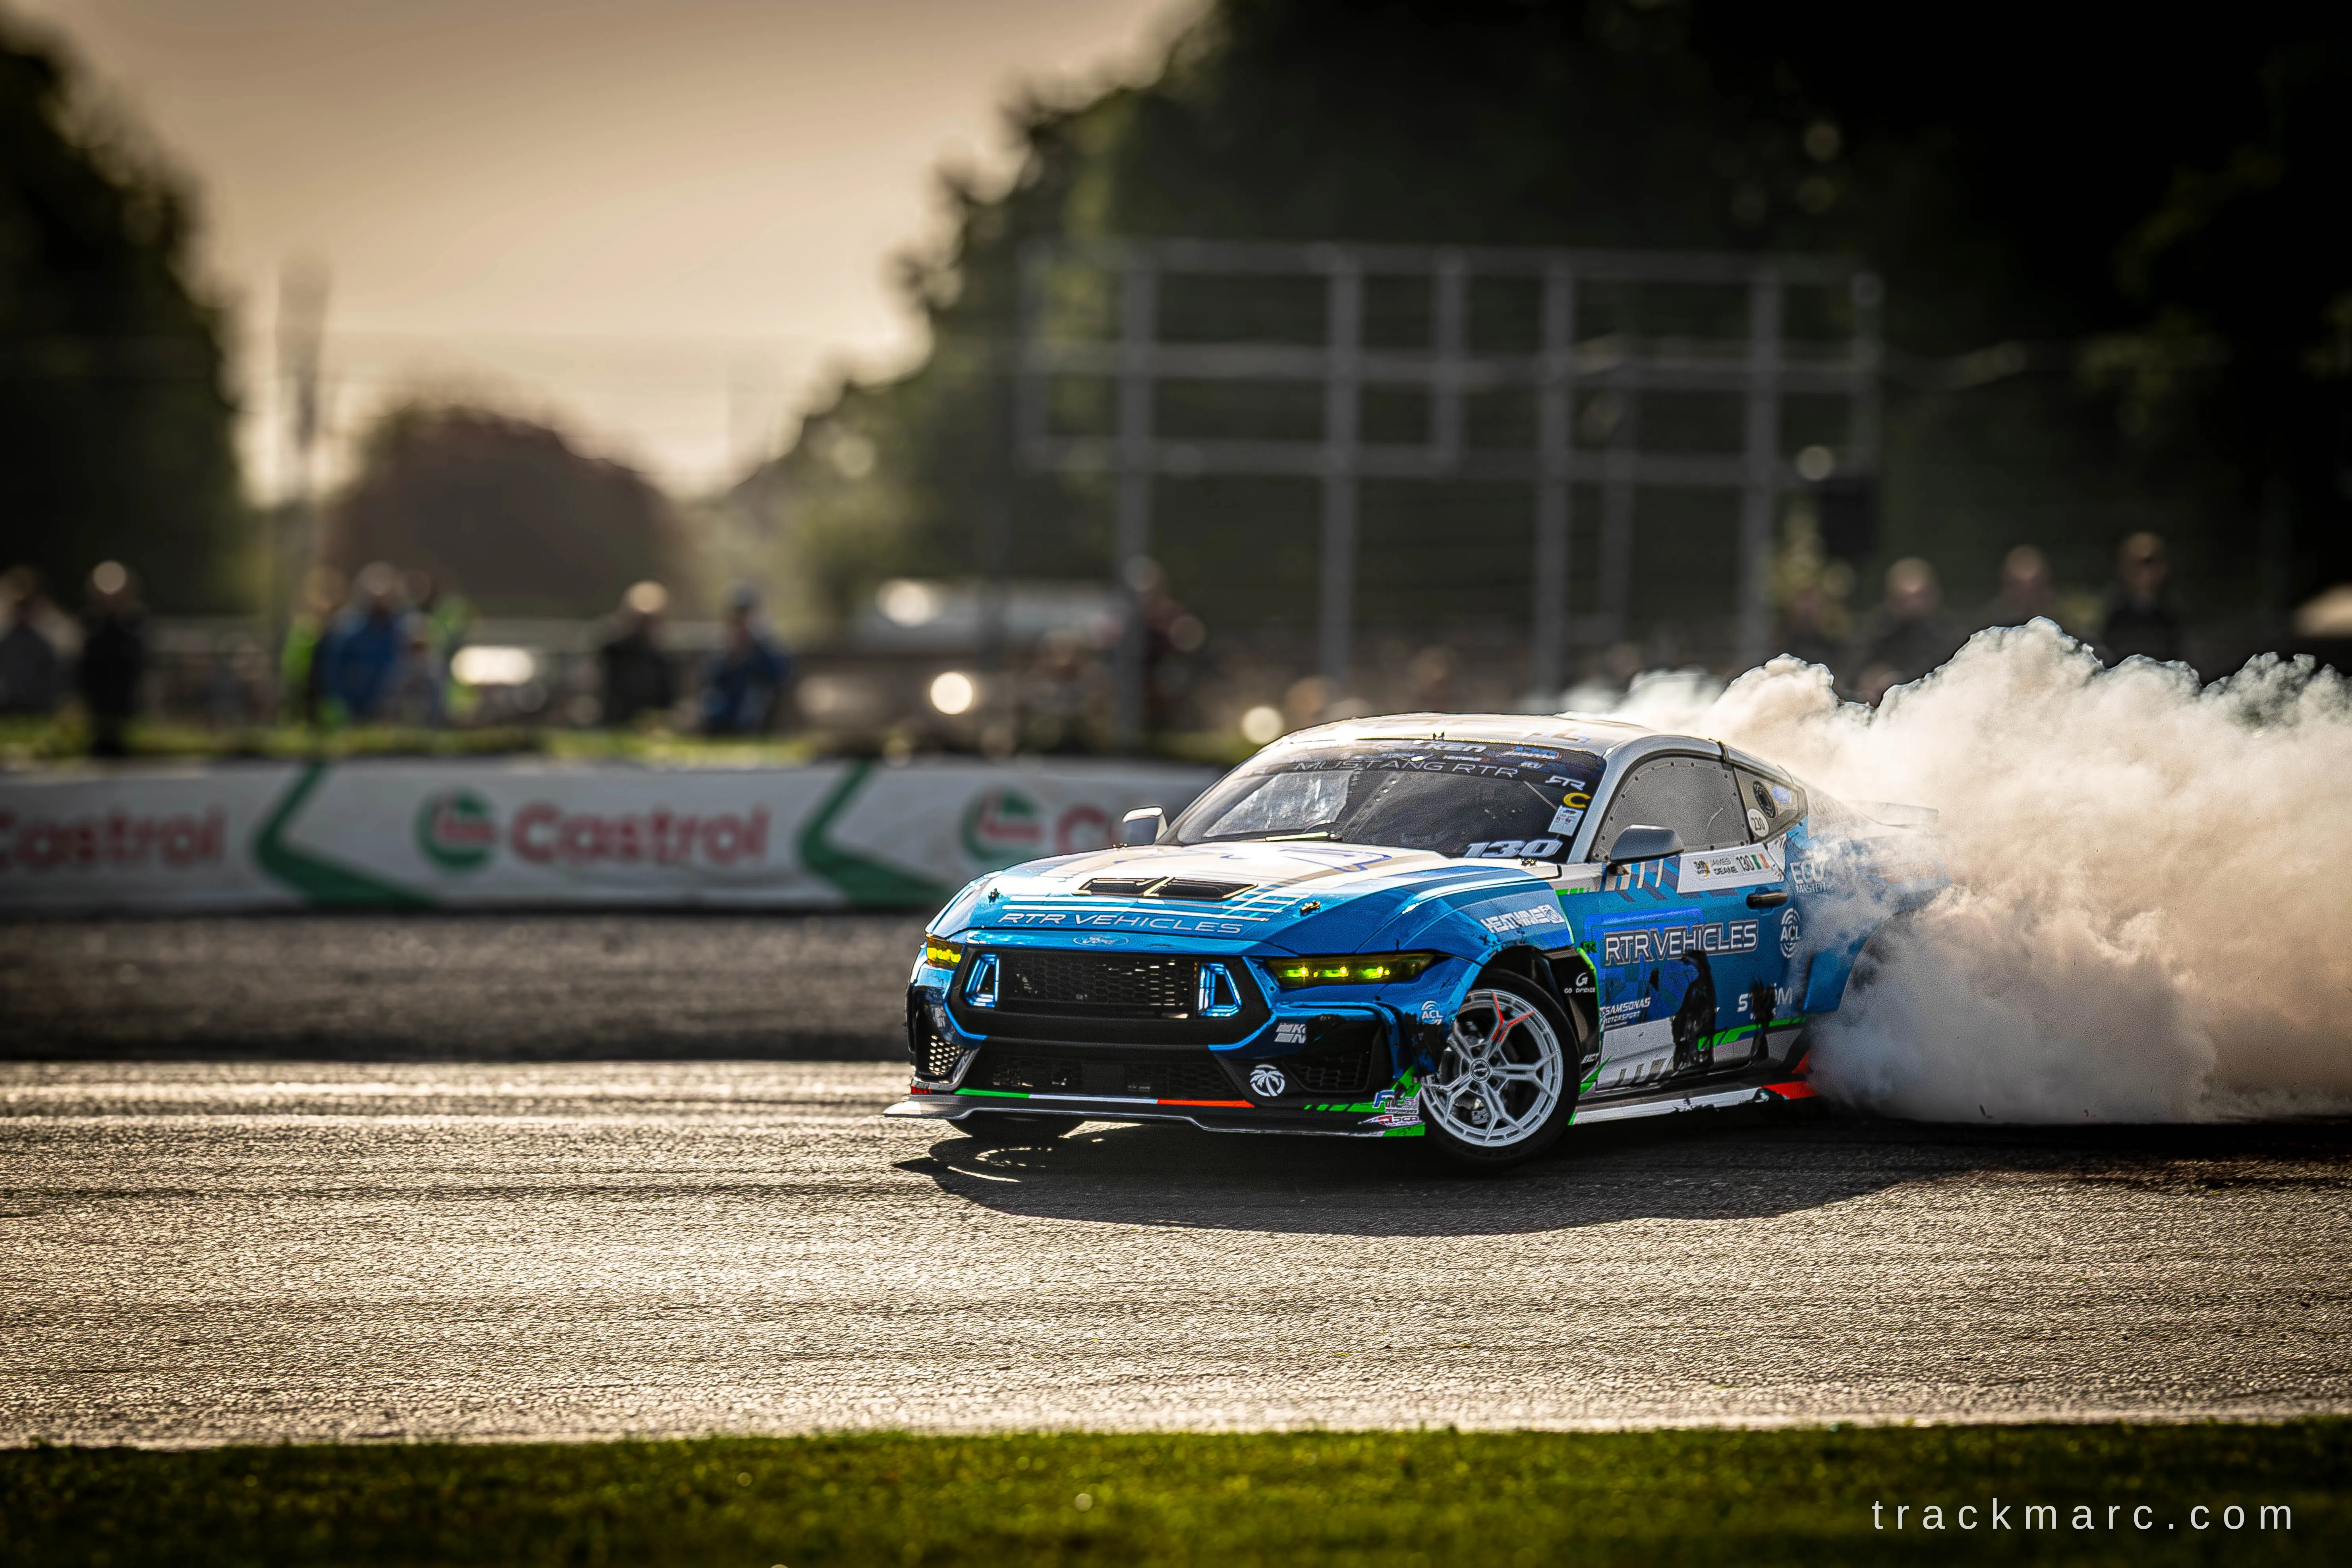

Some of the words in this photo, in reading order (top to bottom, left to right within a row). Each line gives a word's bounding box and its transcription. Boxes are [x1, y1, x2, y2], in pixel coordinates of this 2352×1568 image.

[1294, 759, 1446, 770] MUSTANG
[1452, 763, 1518, 777] RTR
[510, 802, 771, 867] Castrol
[1464, 839, 1563, 858] 130
[1790, 859, 1824, 884] ECU
[998, 913, 1067, 924] RTR
[1075, 914, 1244, 934] VEHICLES
[1780, 925, 1801, 942] ACL
[1606, 934, 1649, 961] RTR
[1653, 924, 1757, 956] VEHICLES
[1422, 1009, 1443, 1019] ACL
